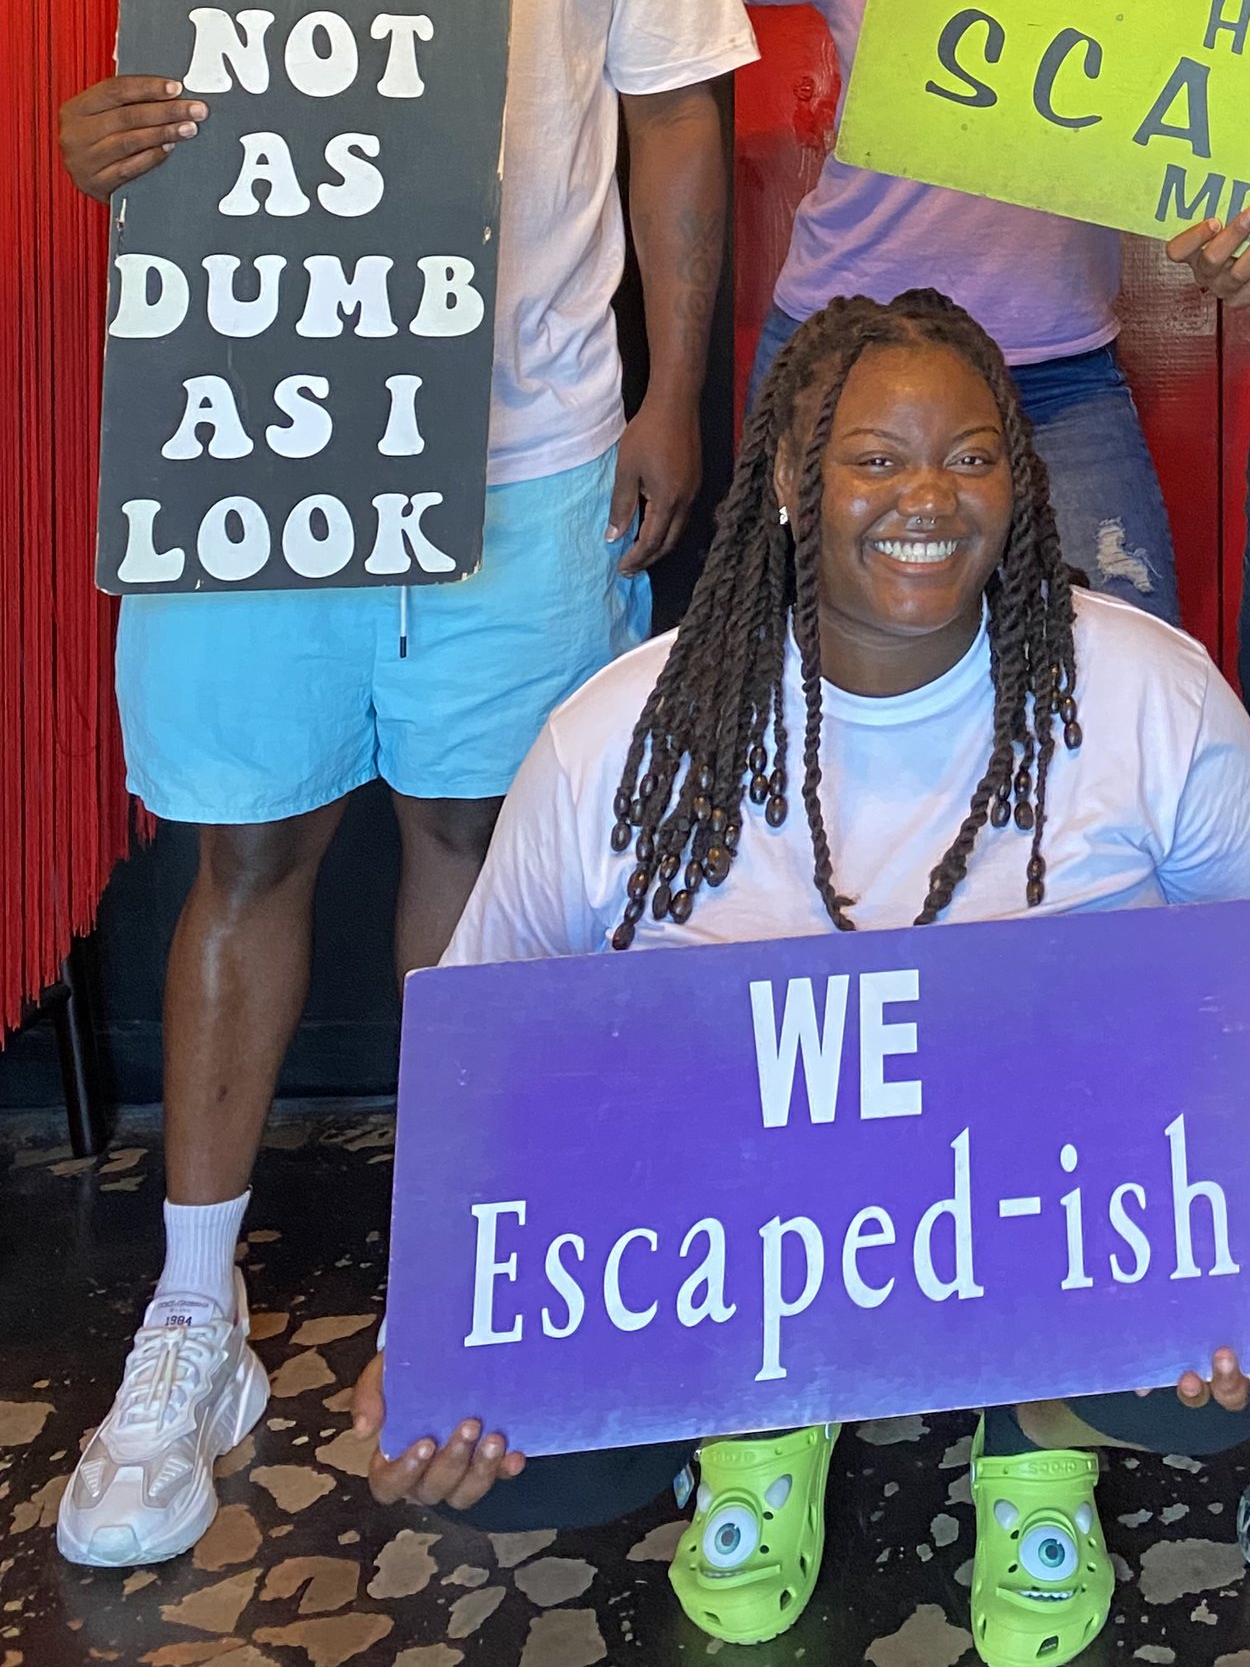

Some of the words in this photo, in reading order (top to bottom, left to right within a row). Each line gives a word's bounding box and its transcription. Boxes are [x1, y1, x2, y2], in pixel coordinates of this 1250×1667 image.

[182, 7, 435, 99] NOT
[218, 131, 385, 217] AS
[108, 253, 485, 339] DUMB
[161, 374, 333, 460] AS
[377, 374, 425, 456] I
[117, 491, 457, 583] LOOK
[749, 968, 923, 1128] WE
[463, 1112, 1240, 1382] Escaped-ish
